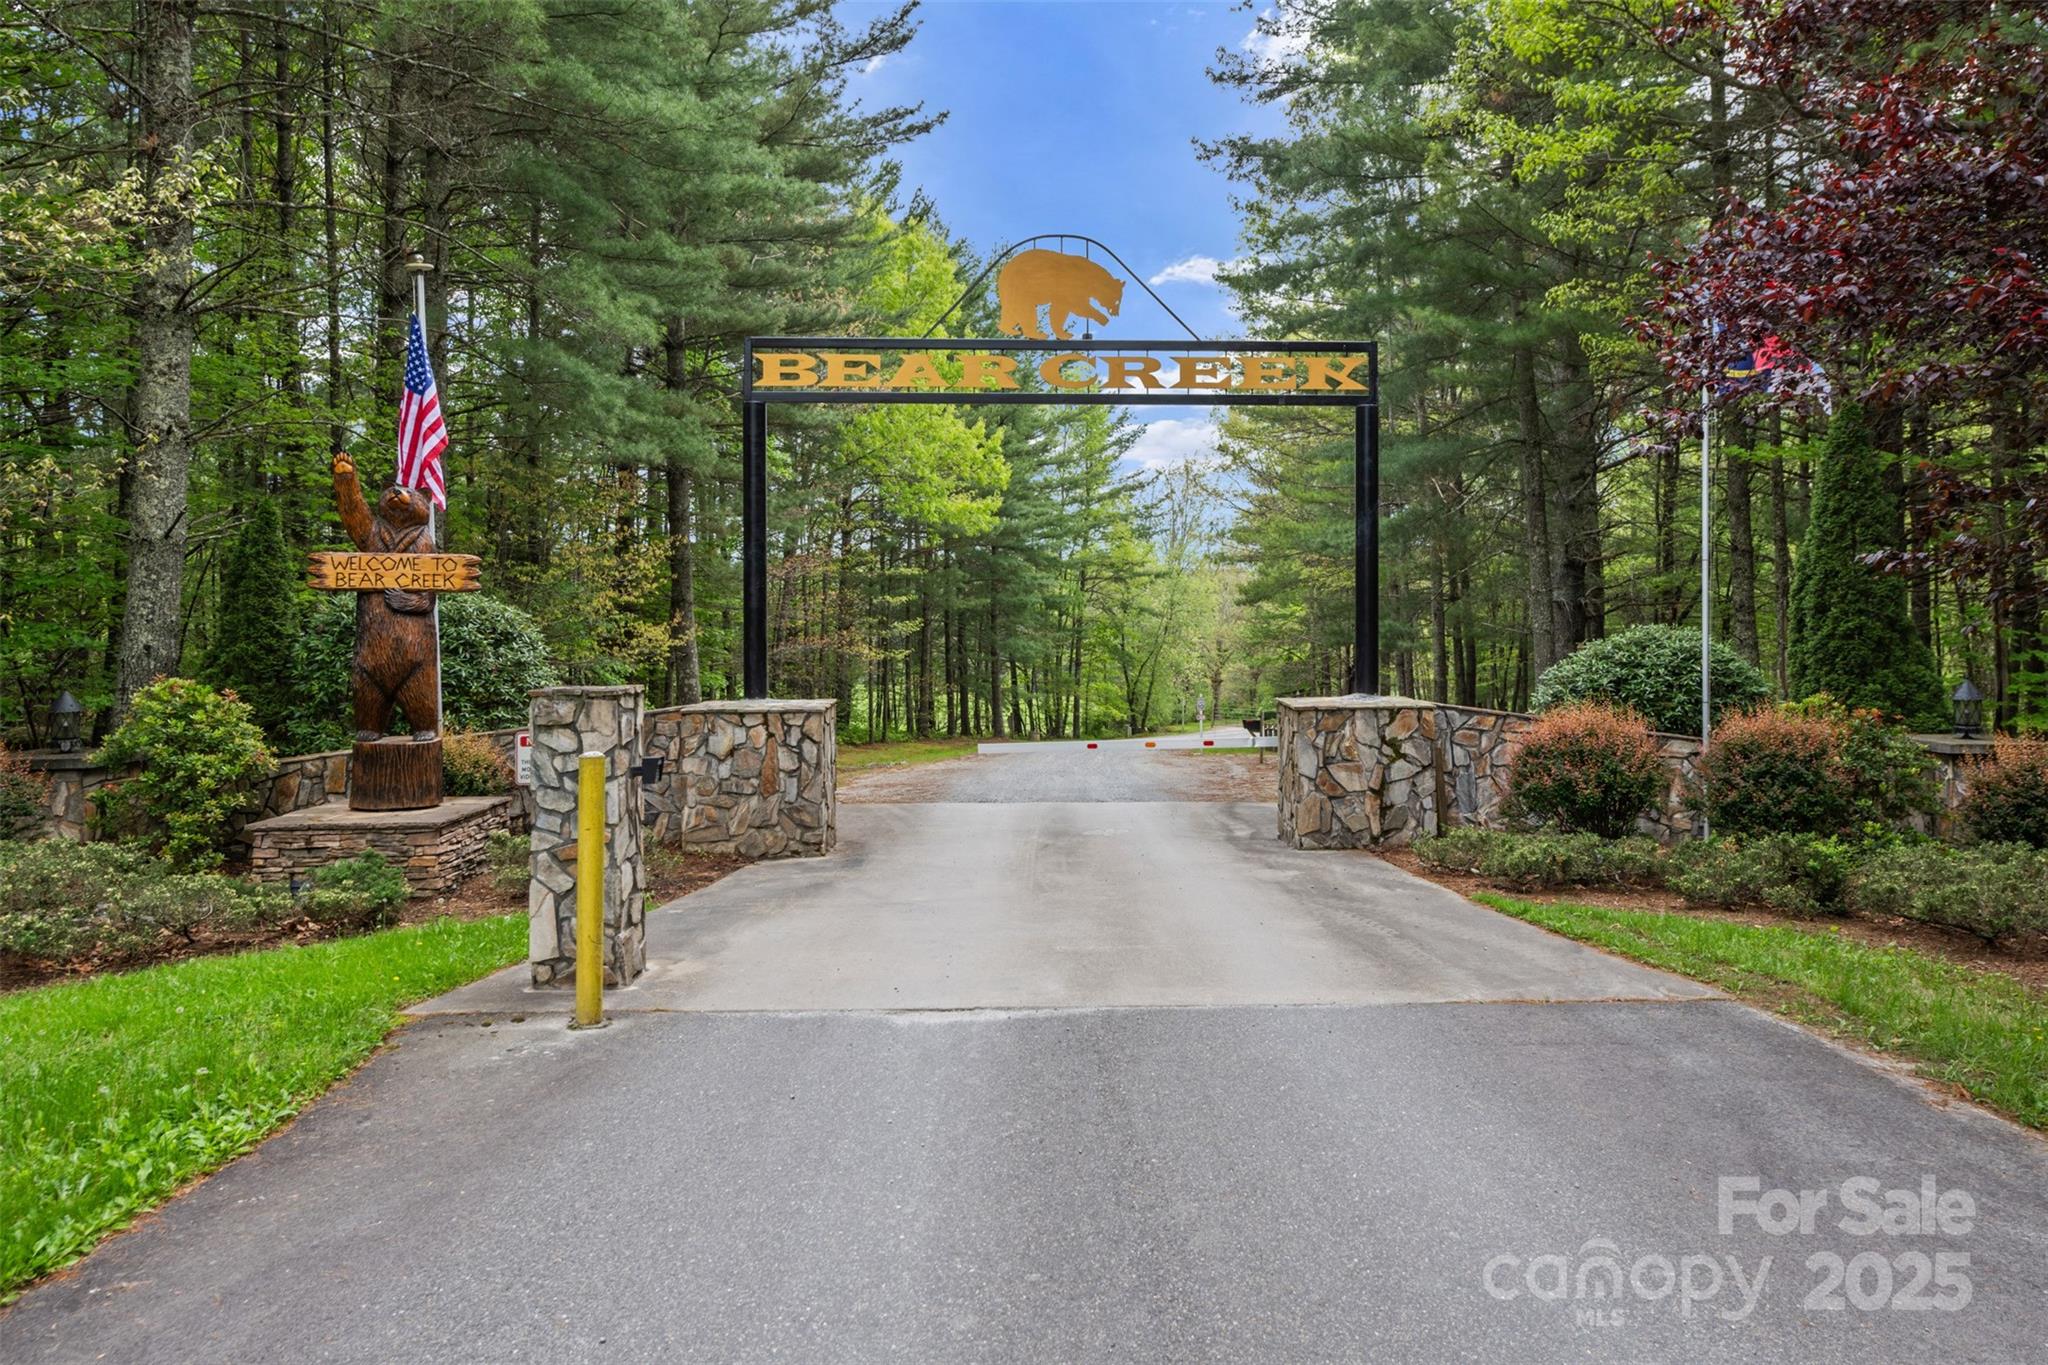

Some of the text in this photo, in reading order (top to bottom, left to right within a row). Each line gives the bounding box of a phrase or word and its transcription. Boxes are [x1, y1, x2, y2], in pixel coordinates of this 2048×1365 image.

[752, 353, 1369, 391] BEAR CREEK
[331, 556, 458, 572] WELCOME TO
[335, 572, 457, 588] BEAR CREEK
